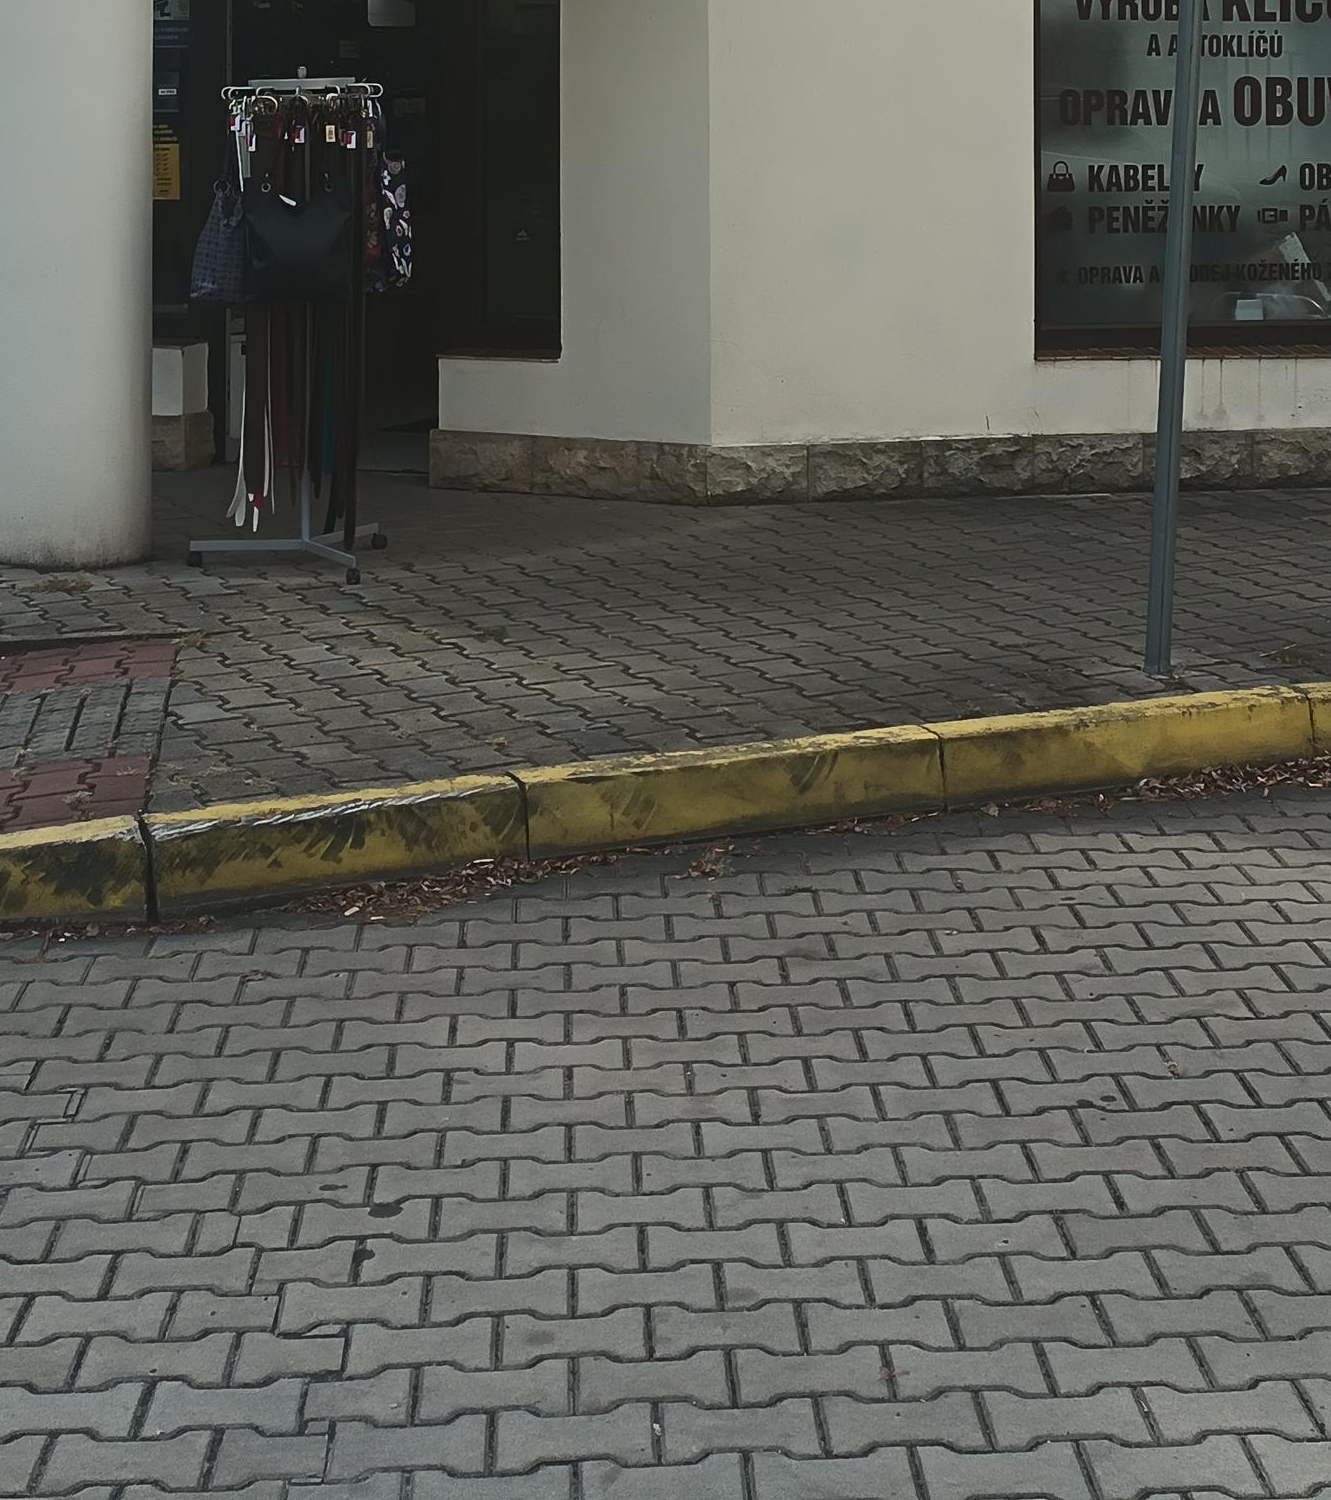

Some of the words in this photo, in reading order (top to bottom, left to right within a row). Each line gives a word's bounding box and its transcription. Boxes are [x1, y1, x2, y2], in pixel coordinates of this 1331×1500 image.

[1147, 34, 1161, 56] A
[1168, 31, 1283, 57] ATOKLÍČŮ
[1059, 89, 1221, 127] OPRAVA
[1089, 164, 1204, 192] KABELY
[1089, 199, 1241, 233] PENĚŽNKY
[1078, 265, 1144, 284] OPRAVA
[1149, 266, 1160, 283] A
[1190, 264, 1229, 282] ODEJ
